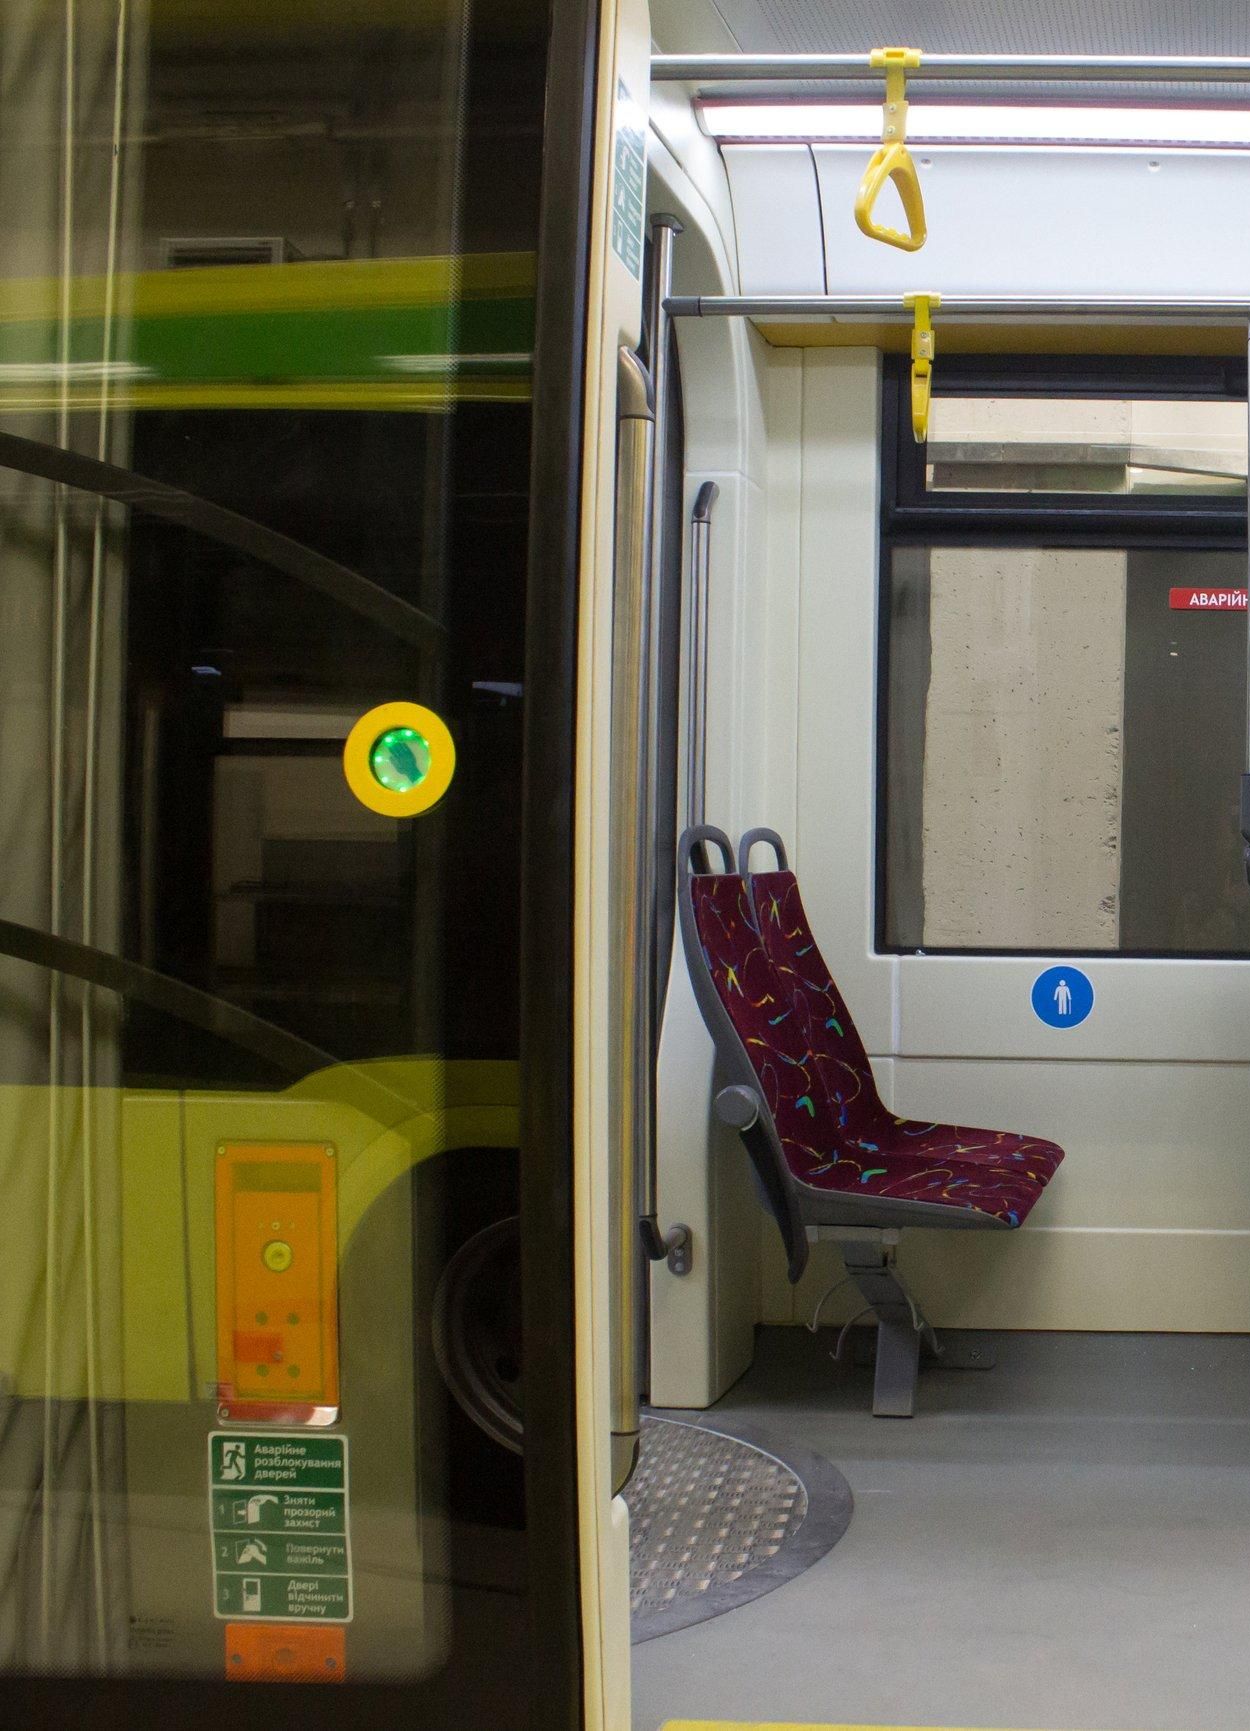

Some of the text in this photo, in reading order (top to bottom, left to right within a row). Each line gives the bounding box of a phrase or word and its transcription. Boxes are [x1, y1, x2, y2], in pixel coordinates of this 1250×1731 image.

[254, 1444, 307, 1456] Аварійне
[254, 1457, 342, 1470] розблокування
[254, 1468, 297, 1480] дверей
[284, 1495, 316, 1505] Зняти
[284, 1507, 336, 1518] прозорий
[284, 1519, 320, 1528] захист
[221, 1547, 229, 1557] 2
[286, 1543, 344, 1555] Повернути
[287, 1580, 319, 1592] Двері
[222, 1589, 230, 1600] 3
[288, 1590, 344, 1603] відчинити
[288, 1604, 327, 1615] вручну
